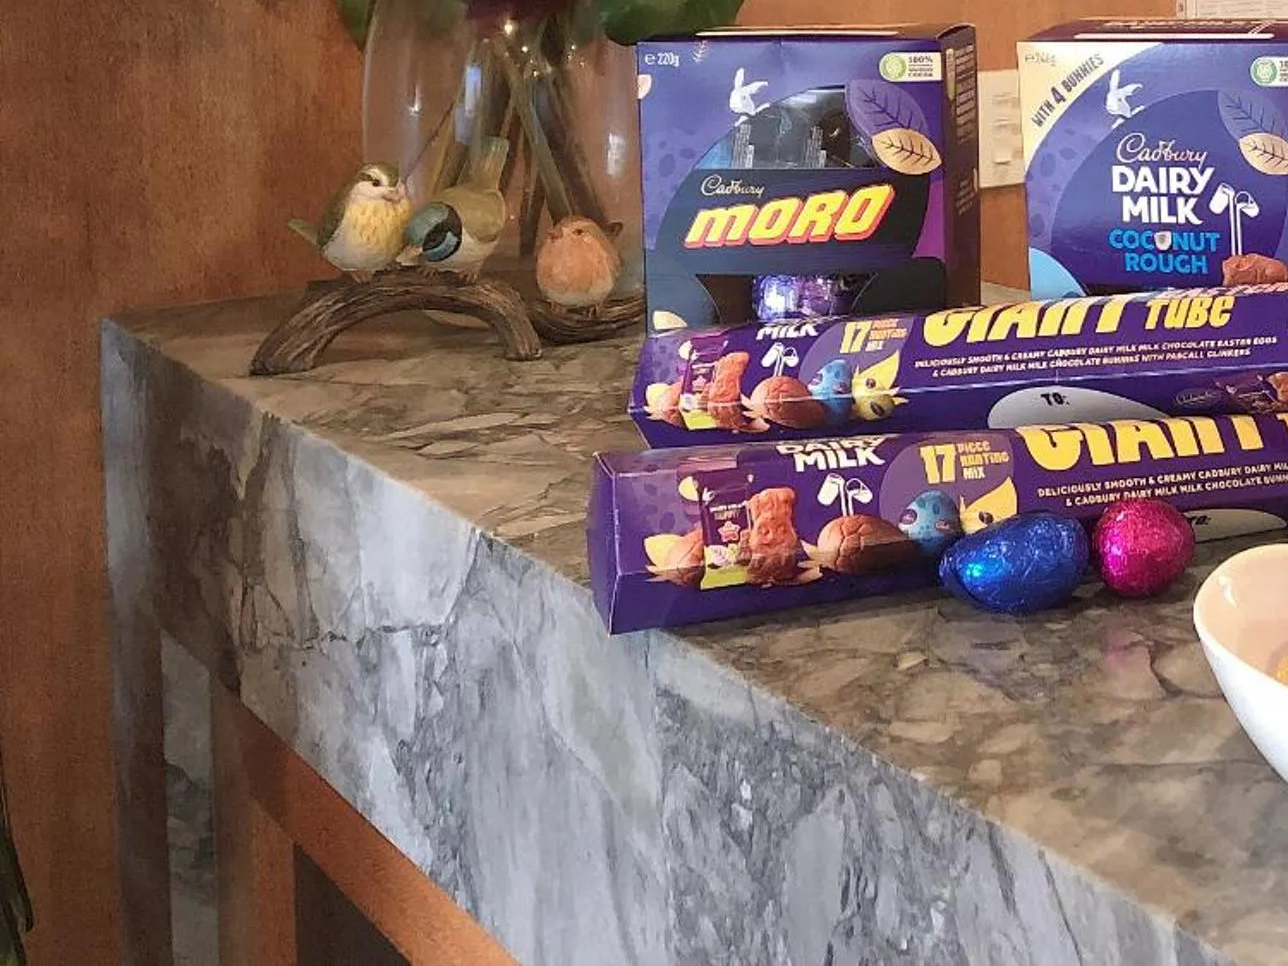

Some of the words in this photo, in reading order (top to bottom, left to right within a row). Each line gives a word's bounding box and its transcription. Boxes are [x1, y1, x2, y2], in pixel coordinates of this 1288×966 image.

[908, 55, 933, 63] 100%
[1031, 100, 1055, 127] WITH
[1051, 86, 1066, 104] 4
[1061, 53, 1104, 92] BUNNIES
[1116, 132, 1207, 170] Cadbury
[700, 174, 765, 197] Cadbury
[1111, 165, 1215, 196] DAIRY
[1121, 196, 1203, 225] MILK
[1108, 229, 1220, 252] COCONUT
[1125, 253, 1209, 275] ROUGH
[840, 320, 872, 354] 17
[914, 357, 966, 368] DELICIOUSLY
[968, 353, 1002, 364] SMOOTH
[1004, 353, 1010, 361] &
[1011, 350, 1046, 361] CREAMY
[1047, 347, 1087, 357] CADBURY
[1089, 346, 1114, 356] DAIRY
[1116, 344, 1137, 353] MILK
[1138, 342, 1159, 351] MILK
[1161, 340, 1215, 350] CHOCOLATE
[1217, 338, 1251, 347] EASTER
[1253, 336, 1277, 345] EGGS
[940, 366, 978, 376] CADBURY
[980, 364, 1004, 374] DAIRY
[1006, 362, 1026, 372] MILK
[1028, 360, 1048, 370] MILK
[1049, 357, 1100, 368] CHOCOLATE
[1102, 354, 1139, 364] BUNNIES
[1141, 353, 1164, 362] WITH
[1166, 351, 1203, 361] PASCALL
[1206, 348, 1251, 358] CLINKERS
[793, 447, 886, 472] MILK
[920, 444, 956, 484] 17
[963, 467, 986, 480] MIX
[1037, 482, 1101, 497] DELICIOUSLY
[1104, 478, 1146, 489] SMOOTH
[1157, 472, 1196, 484] CREAMY
[1199, 467, 1242, 479] CADBURY
[1244, 463, 1271, 474] DAIRY
[1066, 498, 1072, 506] &
[1074, 493, 1121, 506] CADBURY
[1123, 489, 1151, 501] DAIRY
[1154, 486, 1177, 497] MILK
[1180, 484, 1204, 494] MILK
[1205, 476, 1262, 490] CHOCOLATE
